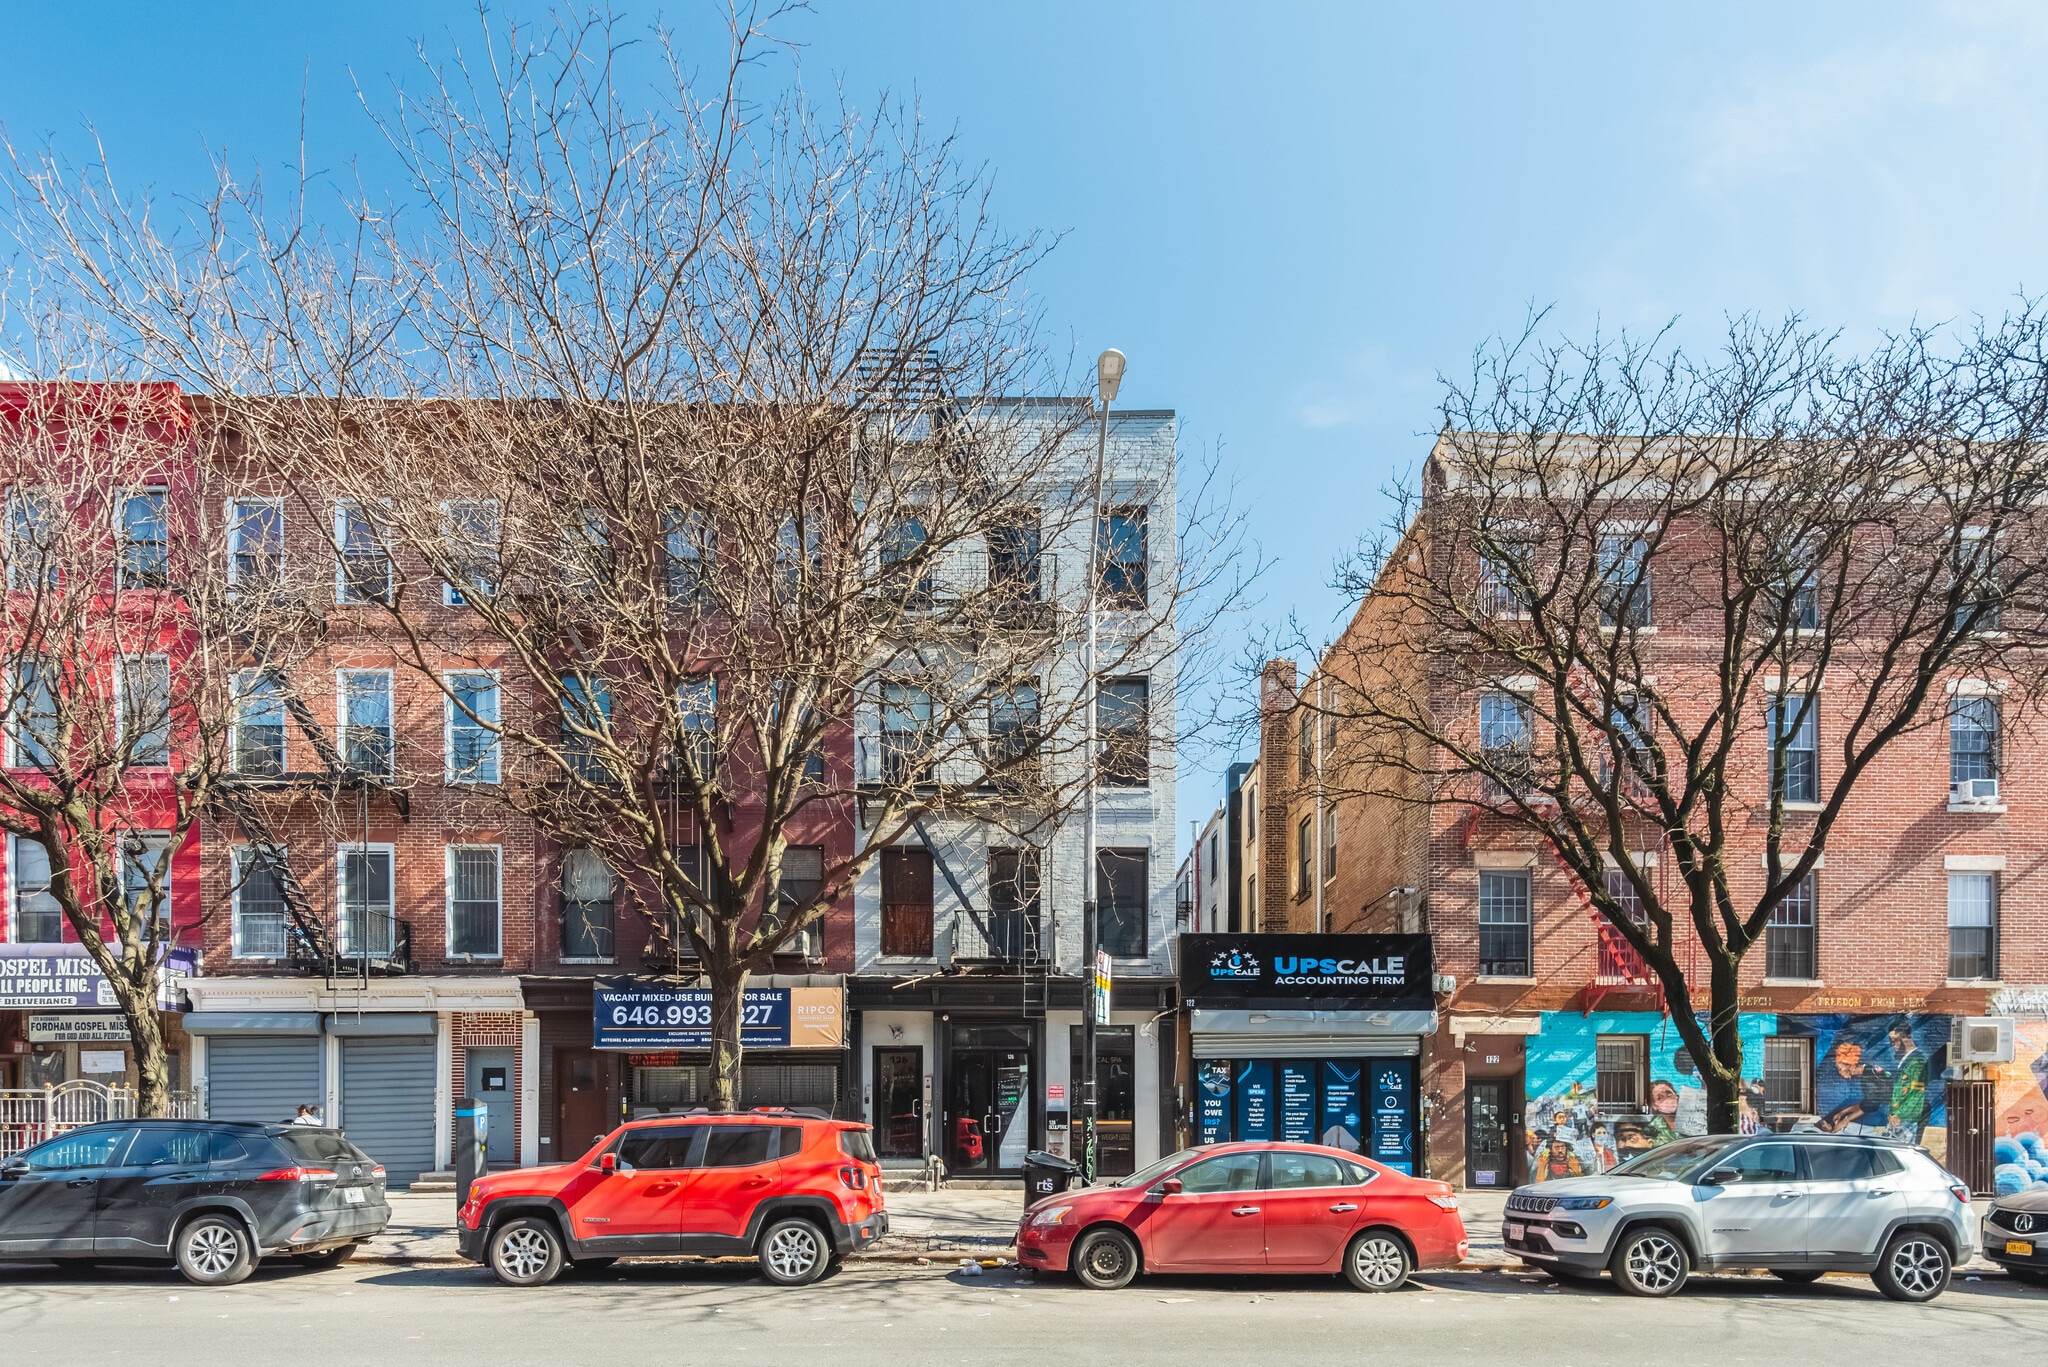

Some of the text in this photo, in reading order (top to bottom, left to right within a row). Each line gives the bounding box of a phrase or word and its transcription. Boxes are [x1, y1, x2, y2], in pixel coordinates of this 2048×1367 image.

[56, 958, 106, 977] MISS
[1274, 957, 1405, 974] UPSCALE
[1210, 968, 1260, 976] UPSCALE
[1275, 976, 1405, 984] ACCOUNTING FIRM
[16, 979, 62, 993] PEOPLE
[65, 978, 91, 993] INC.
[5, 997, 73, 1005] DELIVERANCE
[603, 993, 640, 1002] VACANT
[642, 993, 694, 1002] MIXED-USE
[759, 993, 782, 1001] SALE
[1186, 999, 1195, 1007] 122
[797, 1005, 835, 1015] RIPCO
[31, 1021, 129, 1031] FORDHAM GOSPEL MISS
[104, 1032, 125, 1040] PEOPLE
[1486, 1055, 1499, 1063] 122
[480, 1116, 485, 1128] P
[1036, 1179, 1053, 1191] rts
